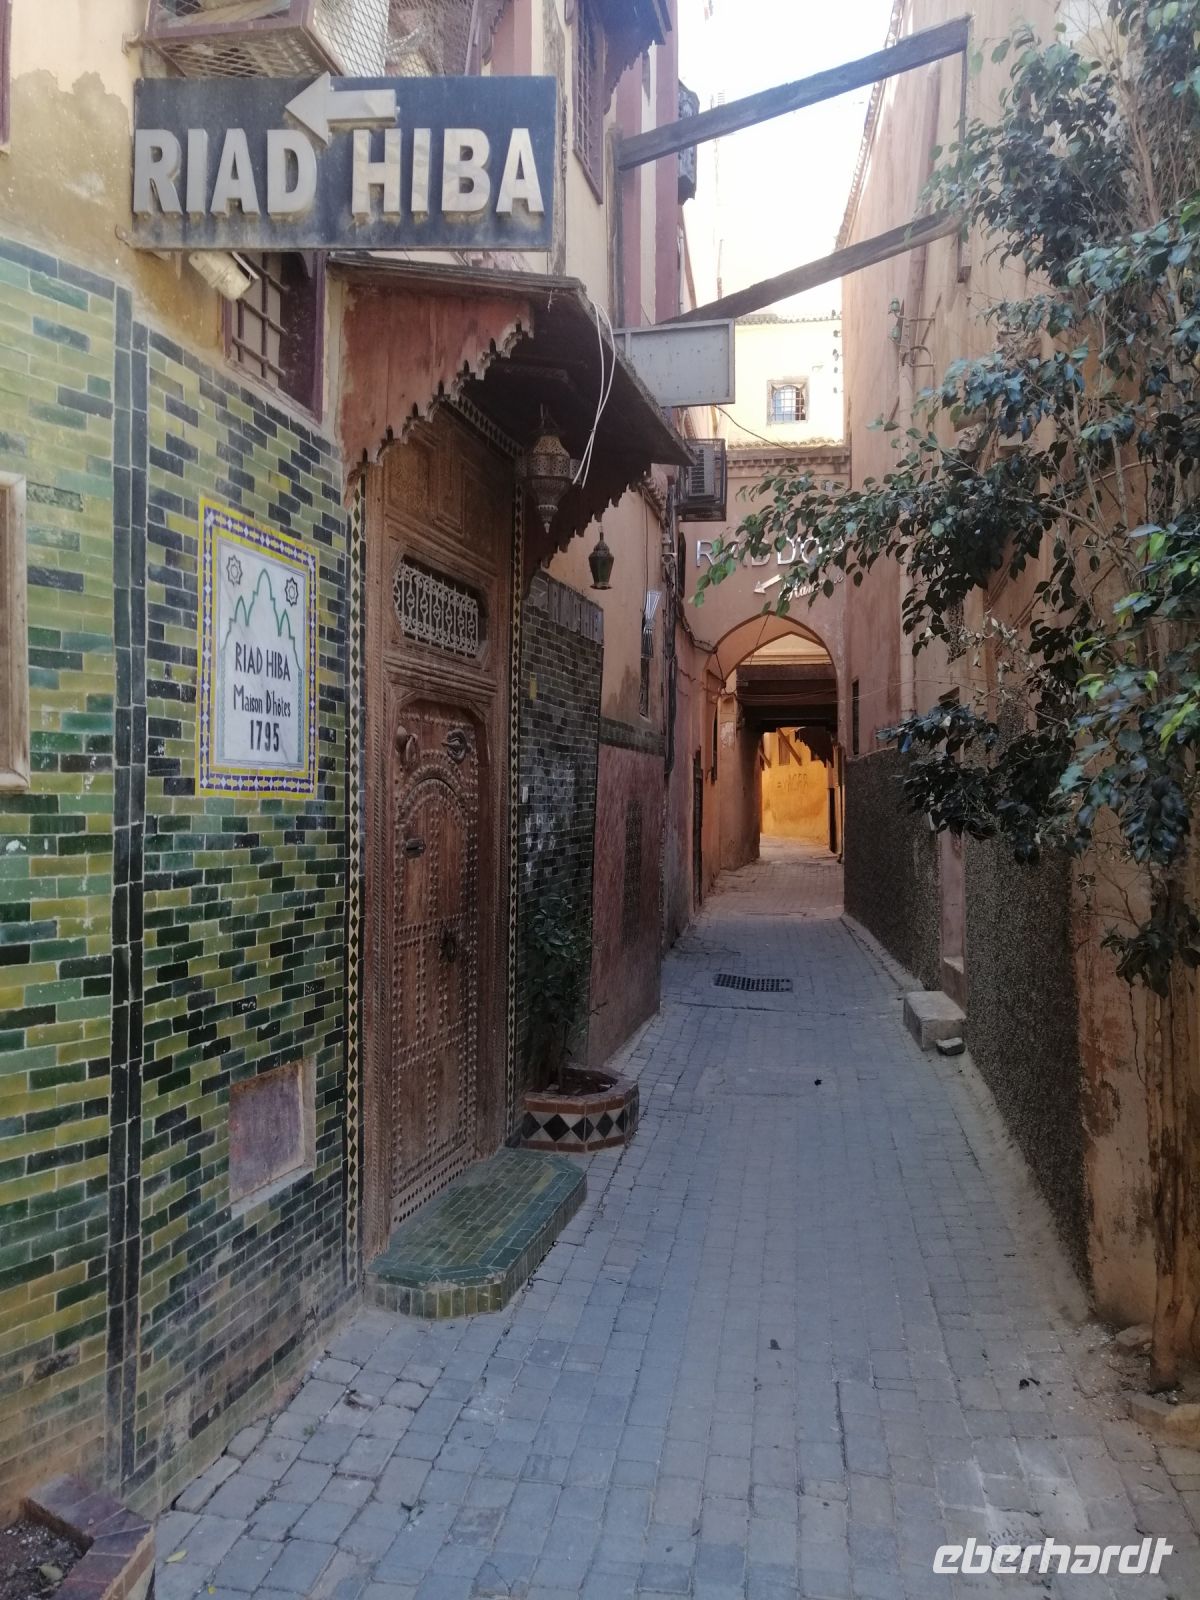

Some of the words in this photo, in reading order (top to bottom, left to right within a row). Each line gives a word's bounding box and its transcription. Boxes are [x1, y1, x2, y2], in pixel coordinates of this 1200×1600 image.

[133, 128, 318, 214] RIAD
[351, 127, 545, 214] HIBA
[696, 537, 771, 567] RD
[235, 641, 264, 675] RIAD
[266, 649, 291, 682] HIBA
[233, 684, 263, 714] Maison
[250, 719, 280, 752] 1795
